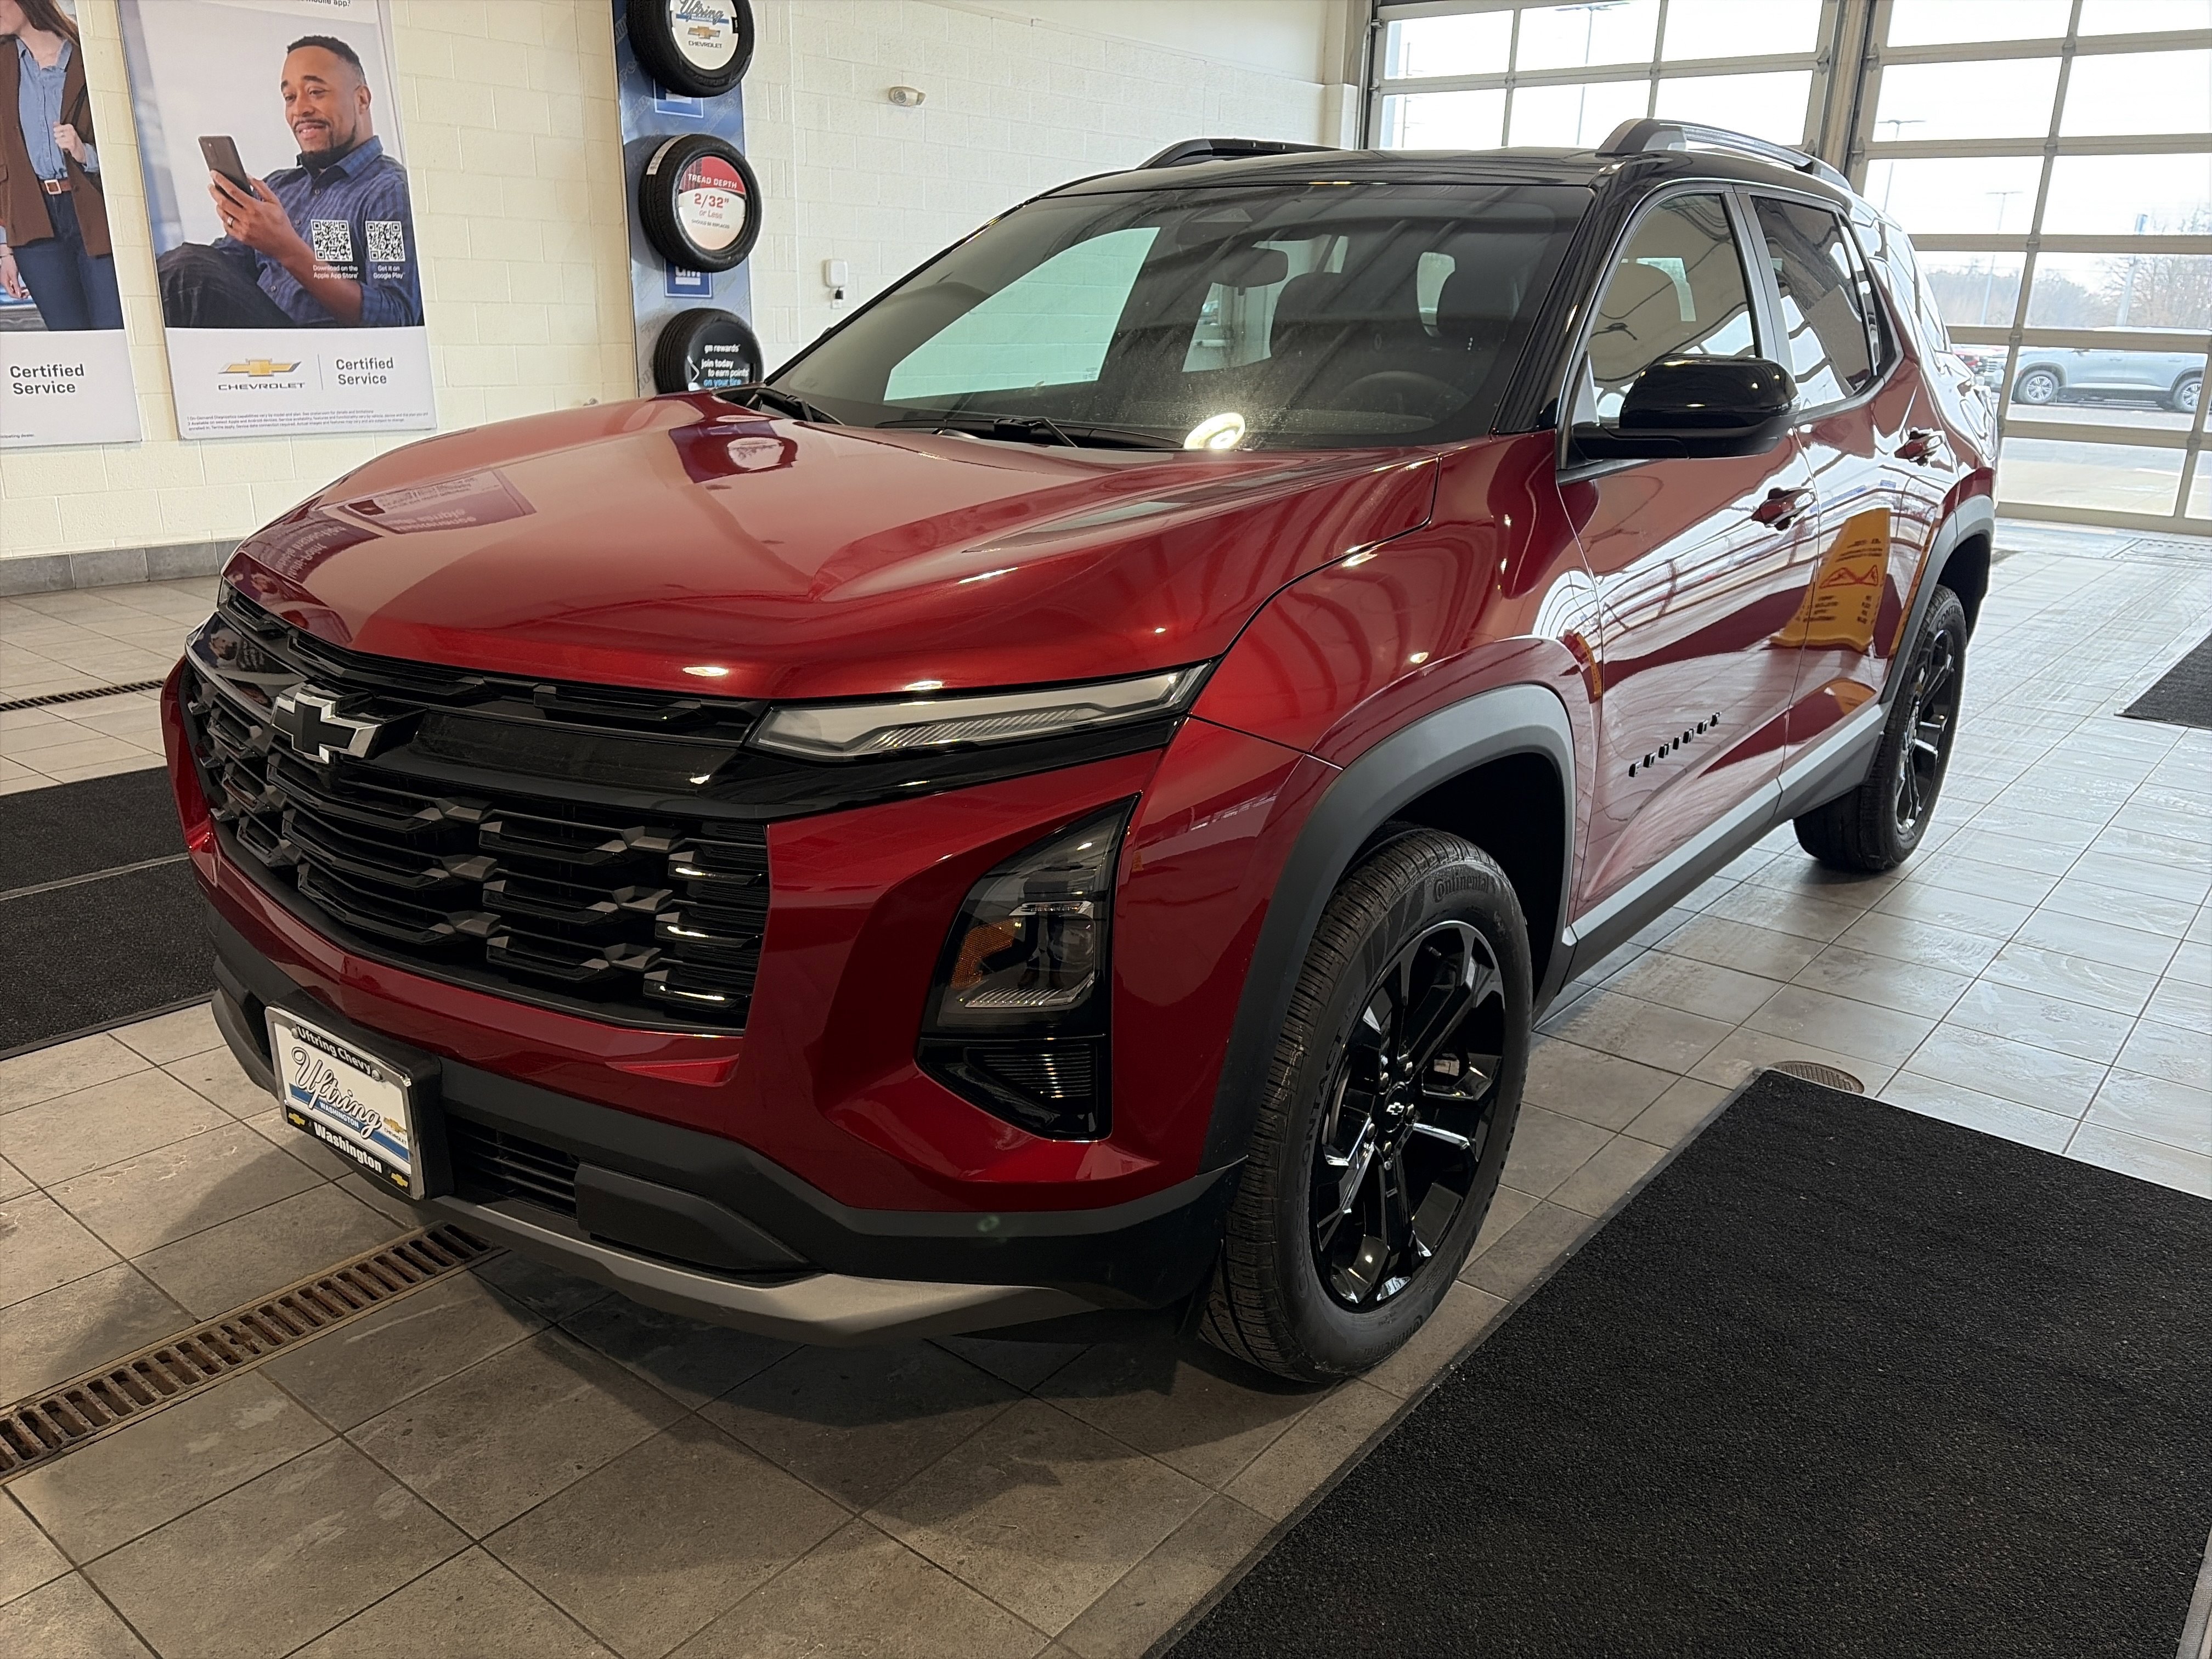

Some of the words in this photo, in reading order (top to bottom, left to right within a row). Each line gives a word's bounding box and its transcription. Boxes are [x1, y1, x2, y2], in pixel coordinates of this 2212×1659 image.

[687, 173, 712, 184] TREAD
[713, 178, 737, 189] DEPTH
[708, 210, 723, 219] Less
[336, 357, 393, 370] Certified
[701, 359, 714, 369] join
[715, 359, 734, 369] today
[10, 364, 84, 378] Certified
[708, 368, 715, 377] to
[338, 373, 387, 385] Service
[714, 379, 729, 387] your
[13, 380, 76, 394] Service
[218, 382, 305, 391] CHEVROLET
[1434, 872, 1489, 902] Continental
[297, 1025, 337, 1058] Uftring
[337, 1047, 371, 1075] Chevy
[291, 1046, 382, 1139] Uftring
[319, 1101, 359, 1128] WASHINGTON
[313, 1121, 382, 1173] Washington
